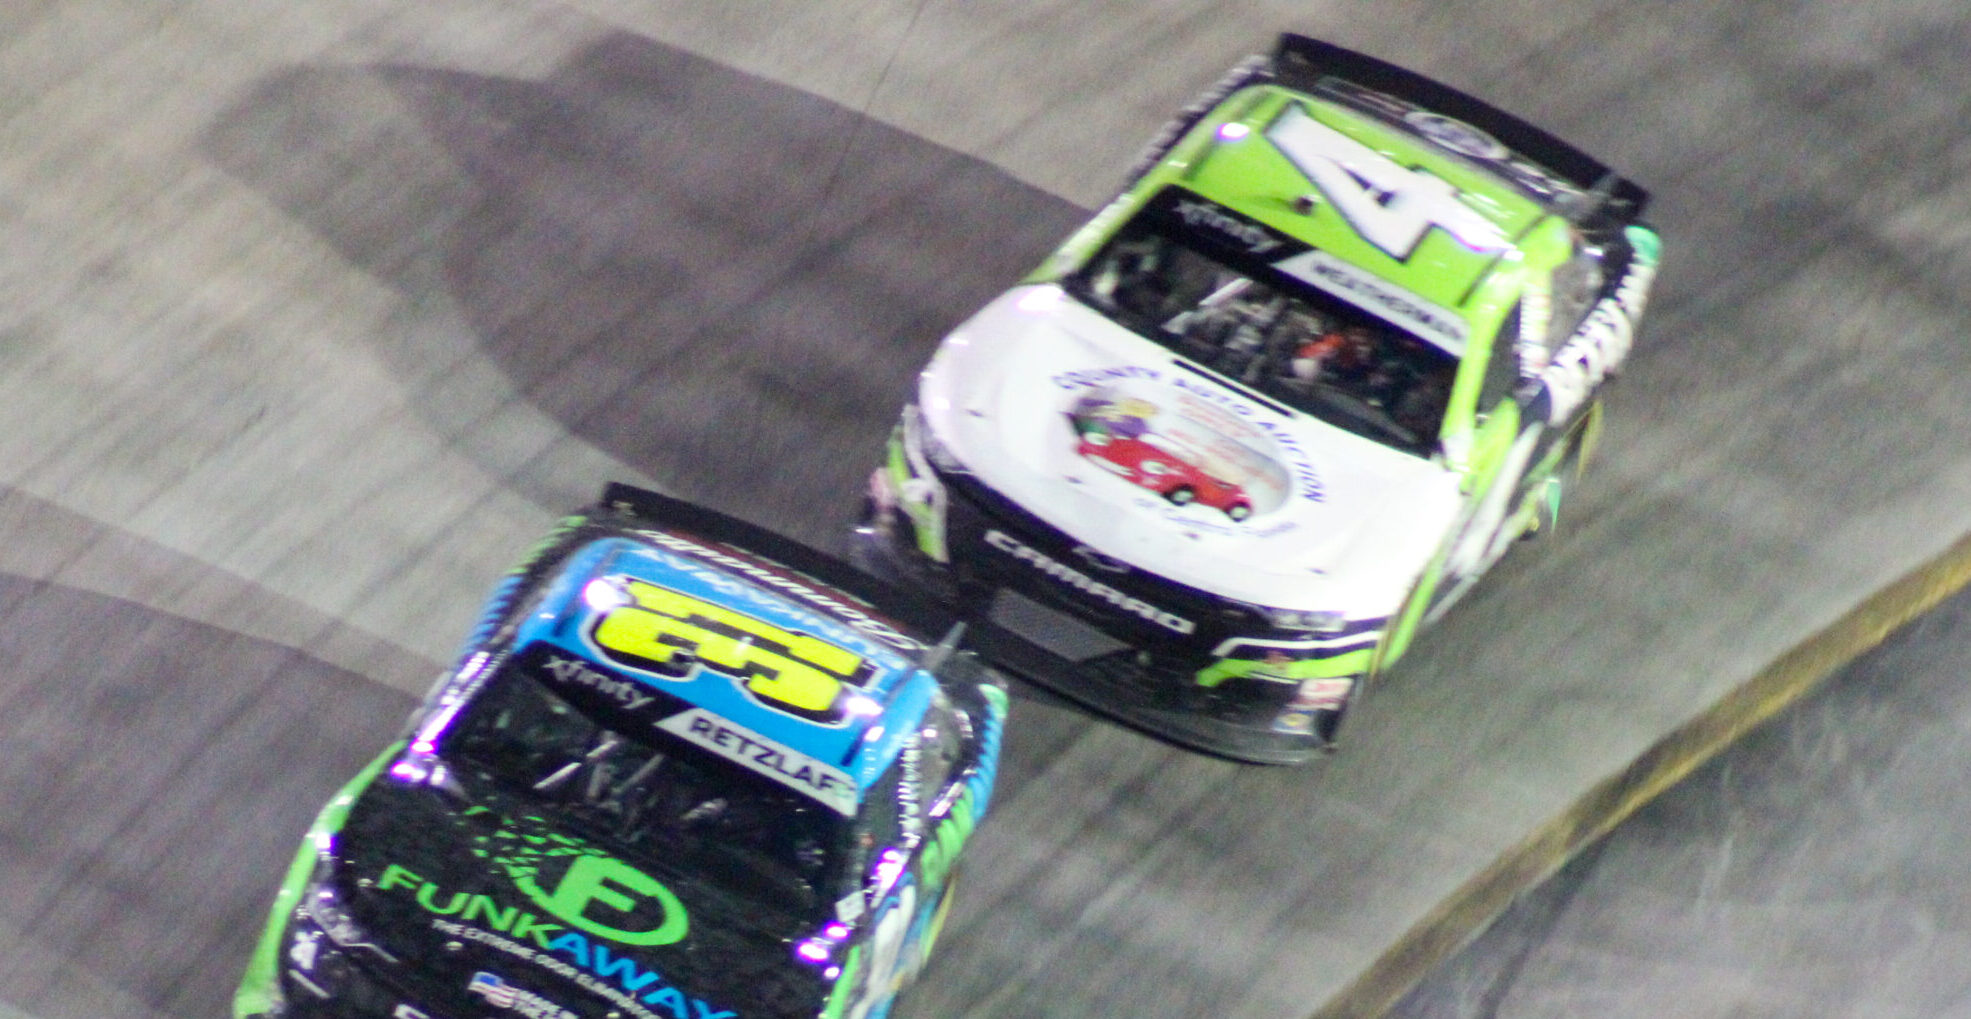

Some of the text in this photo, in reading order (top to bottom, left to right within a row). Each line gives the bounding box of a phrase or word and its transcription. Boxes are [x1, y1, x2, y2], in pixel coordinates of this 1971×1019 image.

[1264, 102, 1520, 262] 4
[984, 529, 1196, 635] CAMARO
[542, 655, 656, 710] xfinity
